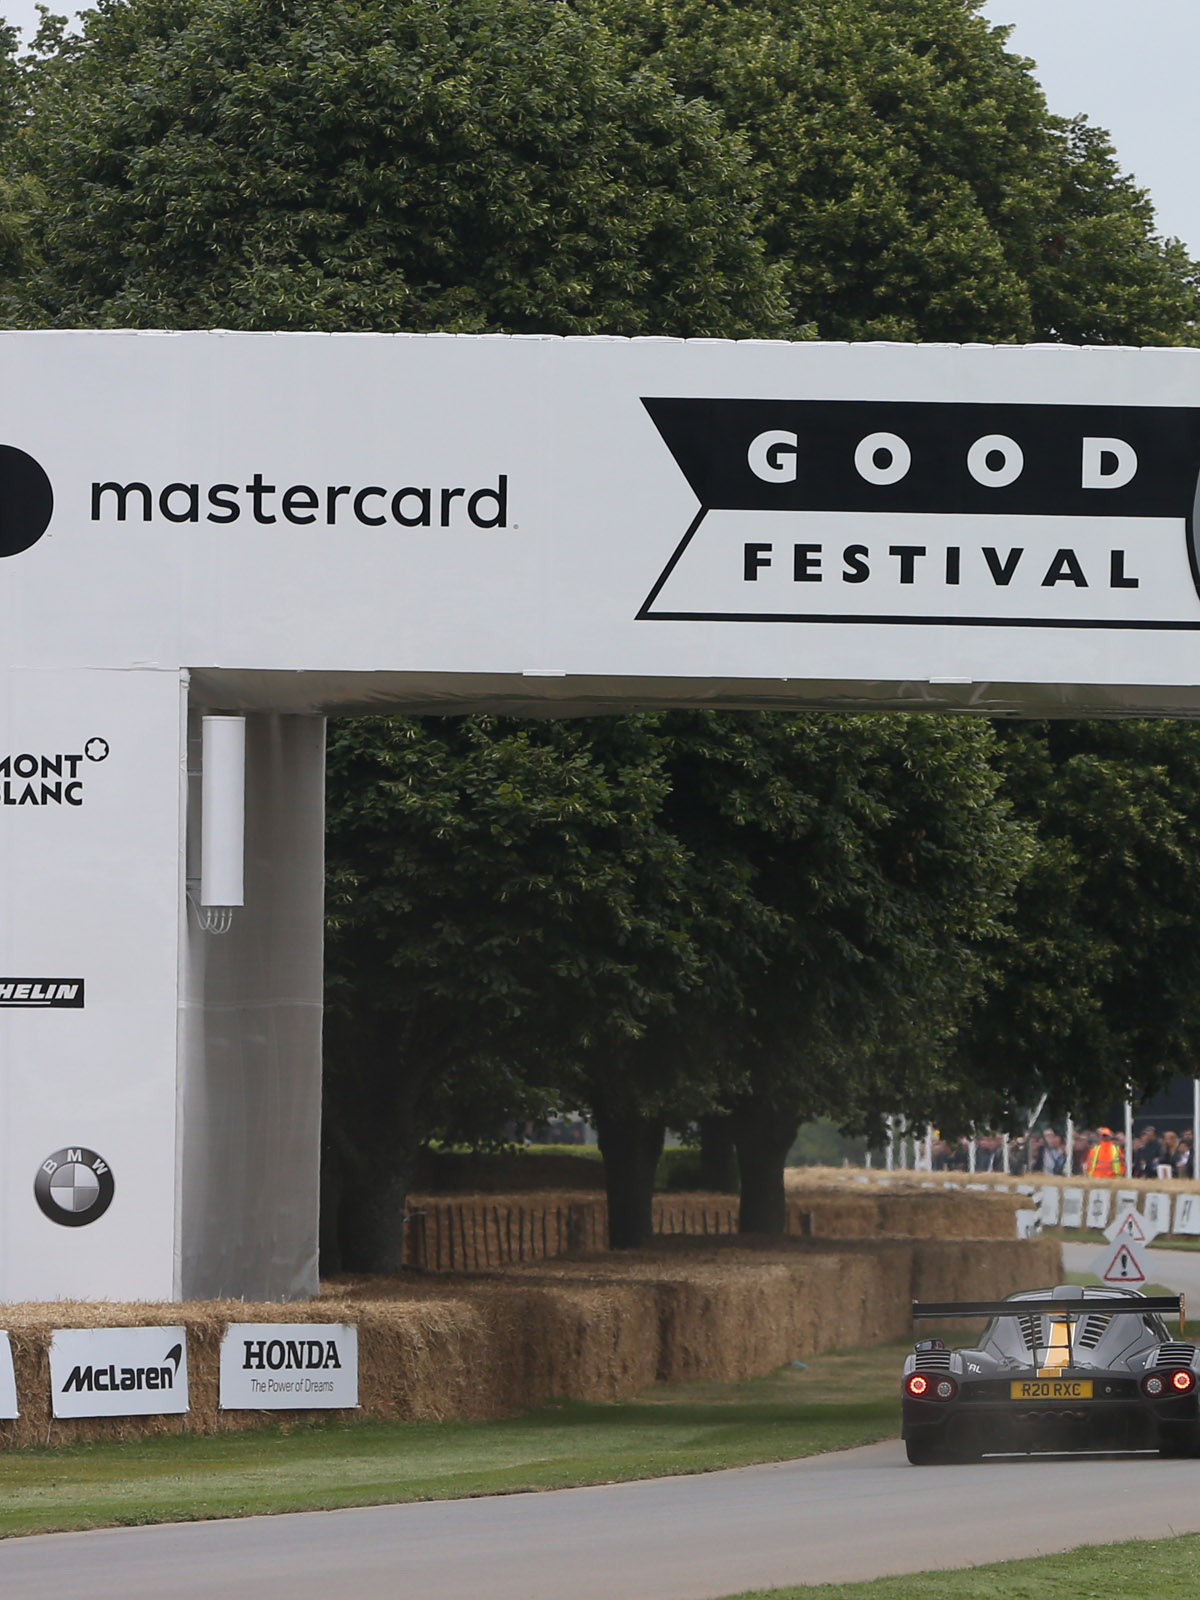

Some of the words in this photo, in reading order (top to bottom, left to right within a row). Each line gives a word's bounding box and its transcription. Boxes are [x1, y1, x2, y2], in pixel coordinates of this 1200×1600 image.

[747, 430, 1139, 489] GOOD
[90, 474, 508, 528] mastercard
[743, 543, 1140, 589] FESTIVAL
[0, 781, 83, 806] LANC
[42, 1149, 108, 1176] BMW
[242, 1340, 342, 1370] HONDA
[61, 1364, 173, 1393] McLaren
[250, 1379, 267, 1393] The
[268, 1379, 294, 1393] Power
[295, 1378, 304, 1393] of
[305, 1378, 334, 1393] Dreams
[1022, 1383, 1050, 1396] R20
[1053, 1383, 1081, 1396] RXC
